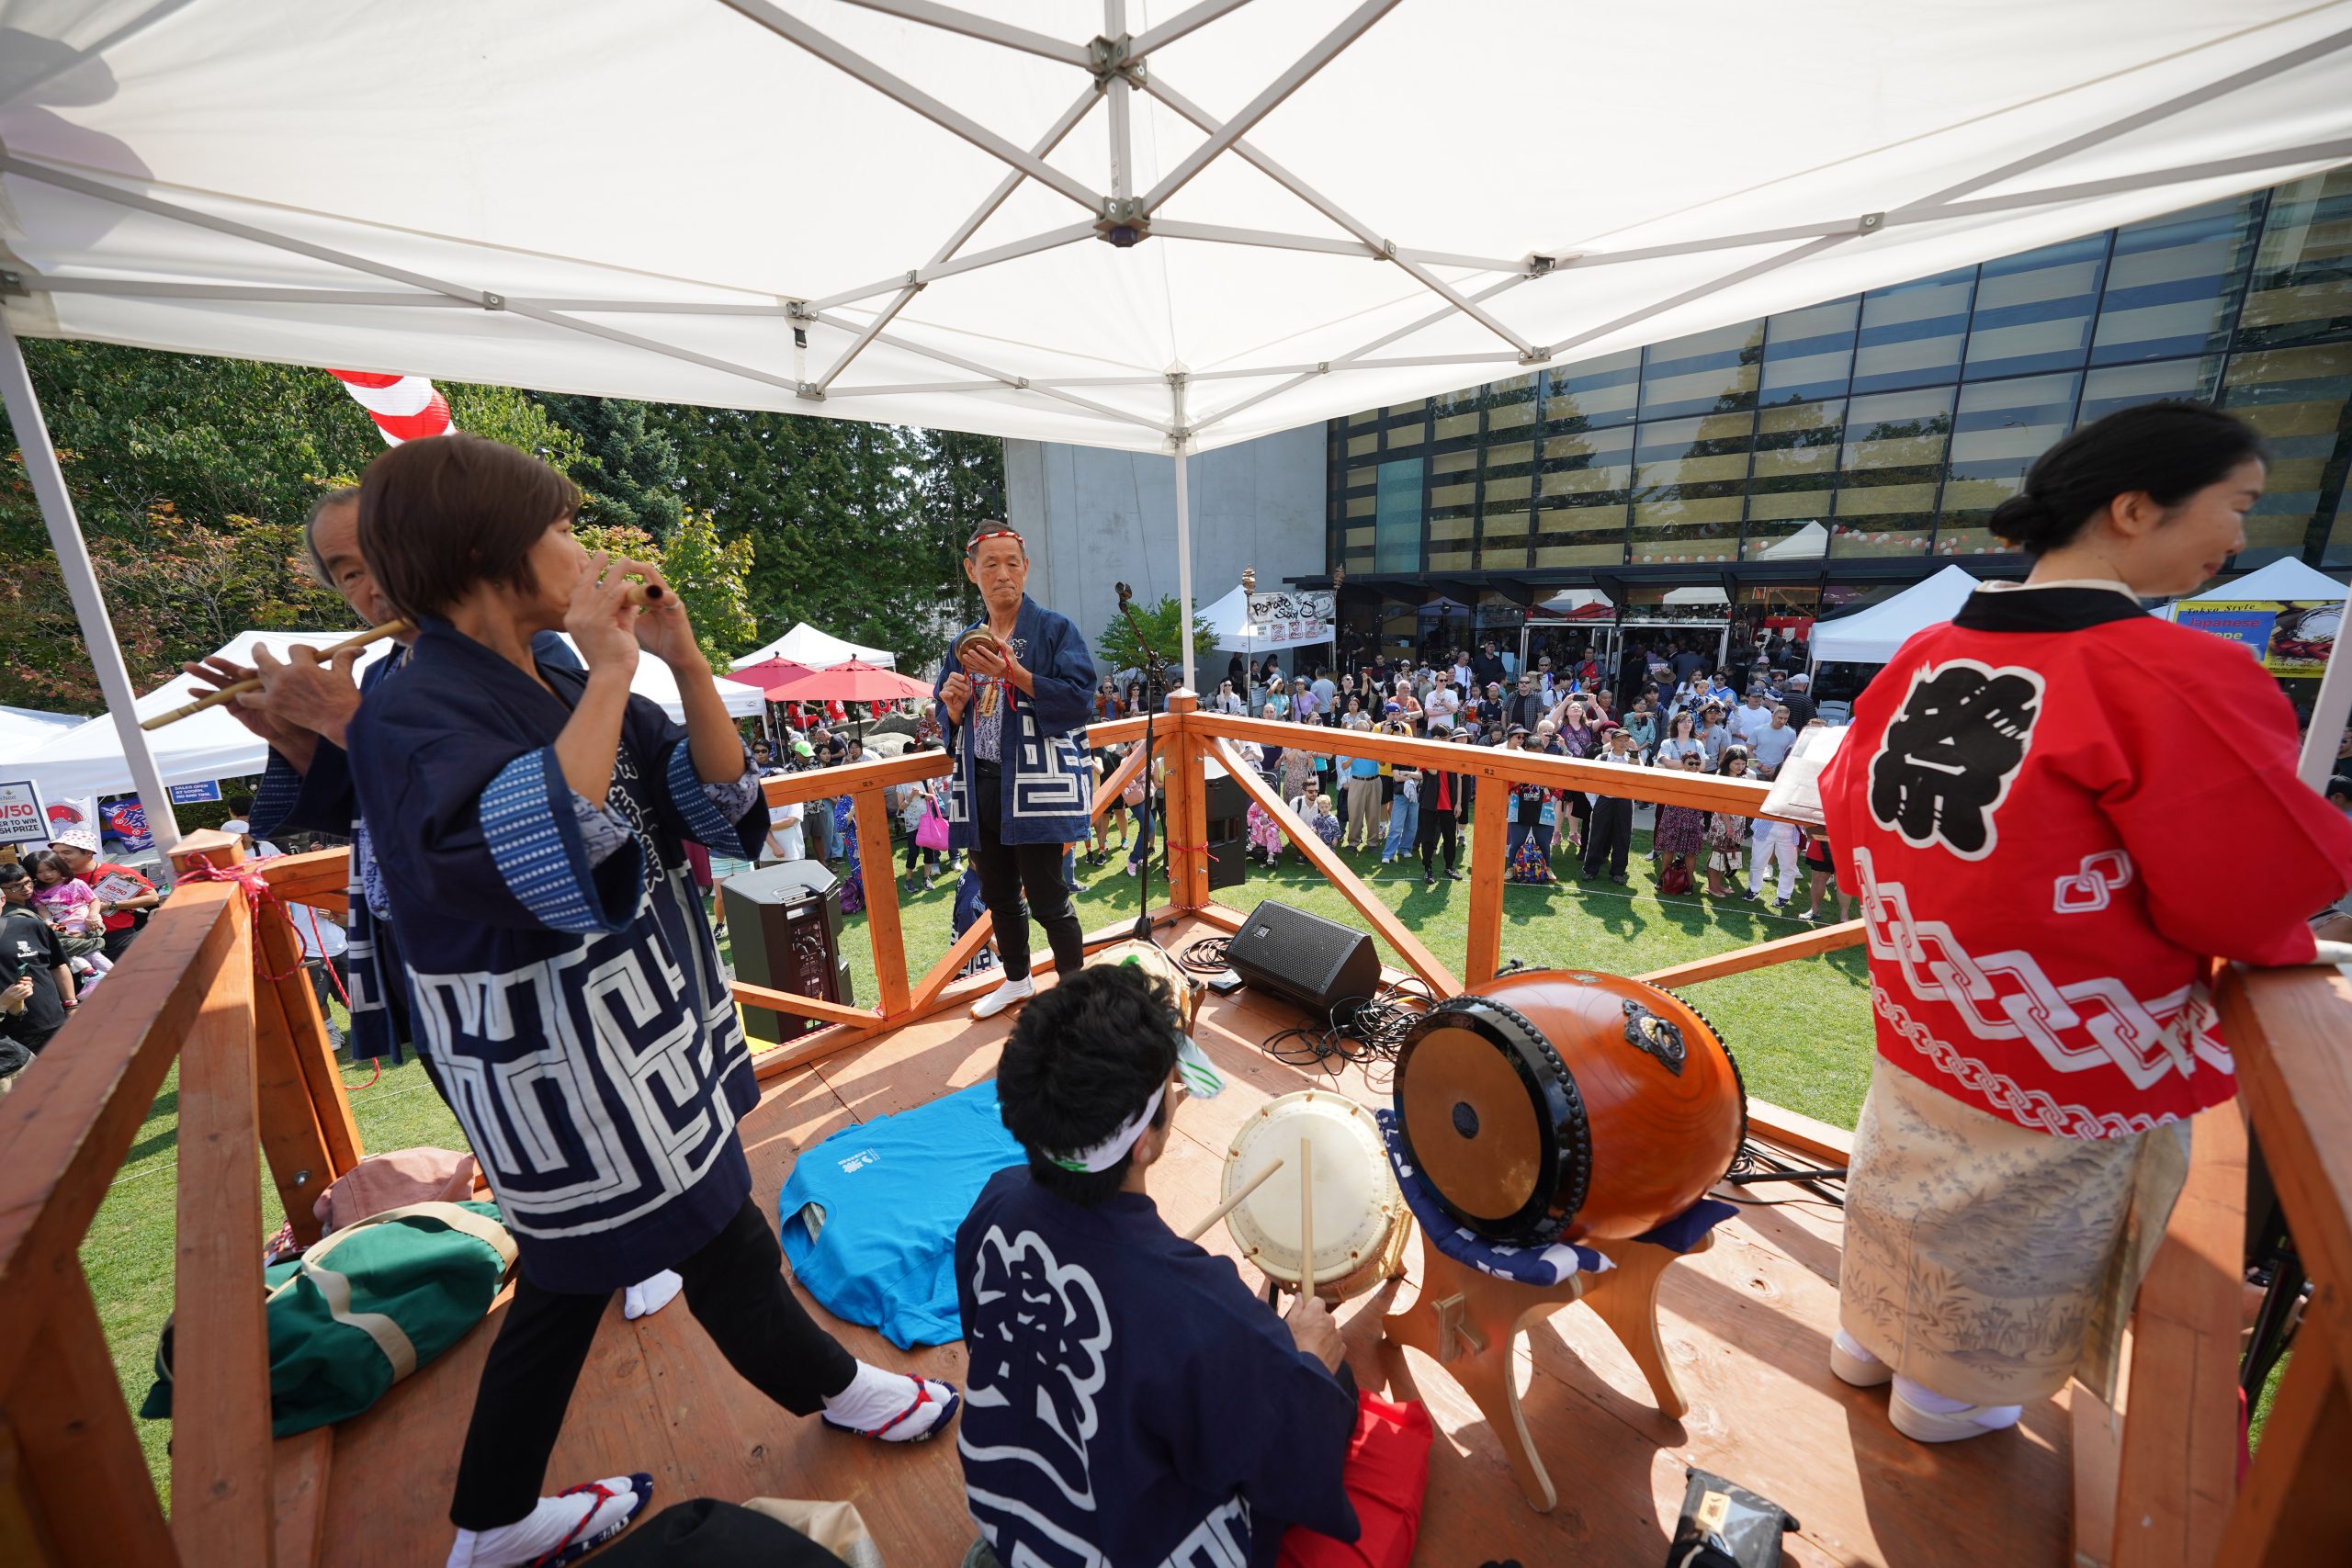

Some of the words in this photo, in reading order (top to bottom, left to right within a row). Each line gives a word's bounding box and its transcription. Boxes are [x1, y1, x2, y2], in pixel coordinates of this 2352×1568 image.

[2223, 604, 2256, 612] Style
[2188, 617, 2260, 628] Japanese
[1868, 659, 2046, 862] 祭
[1484, 768, 1495, 776] R2
[13, 824, 40, 833] PRIZE
[104, 883, 128, 897] 50/50
